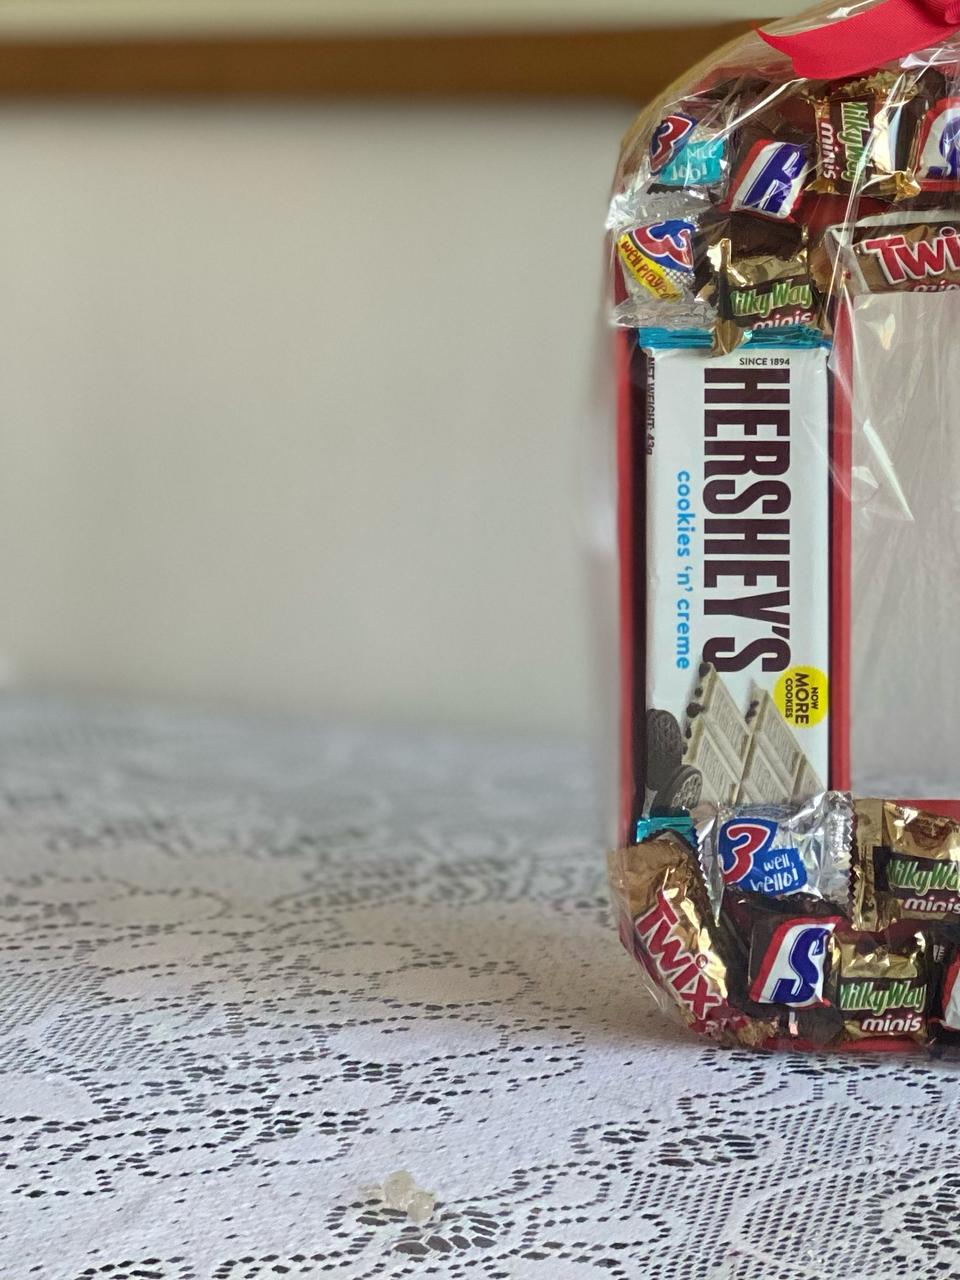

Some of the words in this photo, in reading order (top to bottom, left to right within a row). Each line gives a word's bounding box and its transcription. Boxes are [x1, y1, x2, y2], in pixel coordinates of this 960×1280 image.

[649, 115, 692, 173] 3
[821, 122, 836, 180] minis
[740, 358, 768, 366] SINCE
[770, 358, 790, 366] 1894
[676, 470, 696, 558] cookies
[702, 367, 791, 673] HERSHEY'S
[676, 598, 691, 670] creme
[785, 677, 793, 719] COOKIES
[795, 672, 810, 725] MORE
[811, 686, 819, 710] NOW
[720, 823, 770, 885] 3
[769, 928, 831, 1004] S
[861, 1014, 922, 1032] minis
